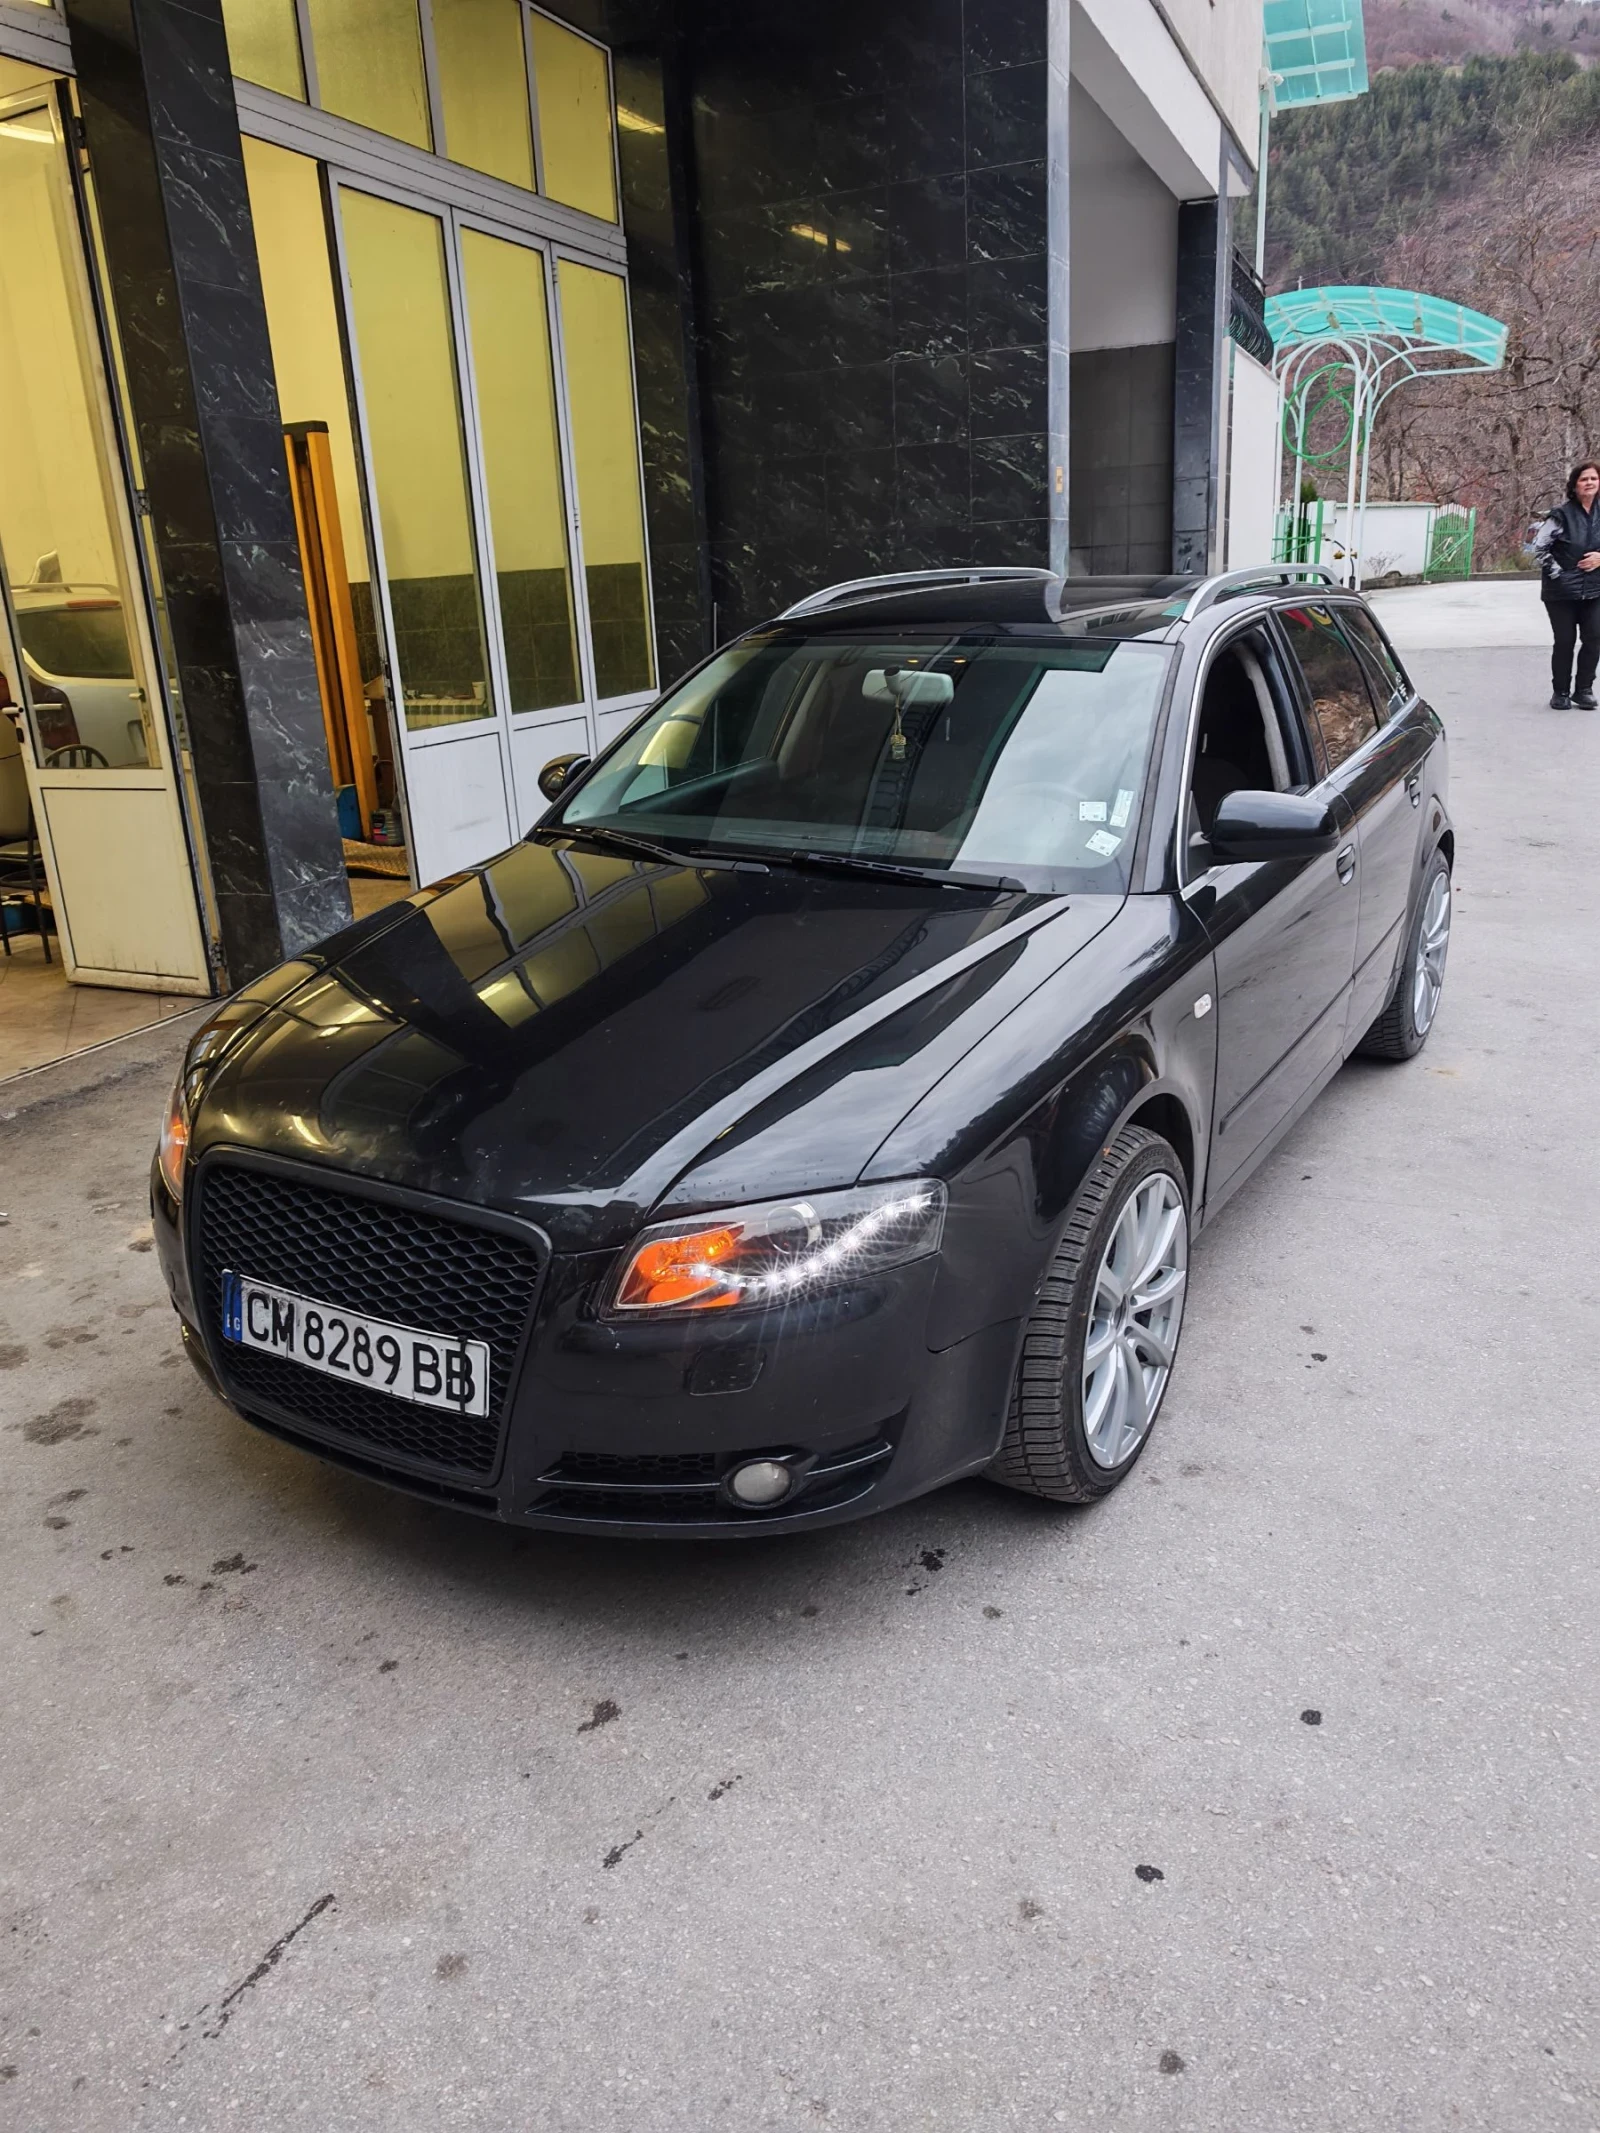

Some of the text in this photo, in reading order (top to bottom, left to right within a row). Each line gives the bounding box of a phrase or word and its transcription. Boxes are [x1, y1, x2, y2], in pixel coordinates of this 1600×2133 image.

[247, 1291, 476, 1404] CM 8289 BB
